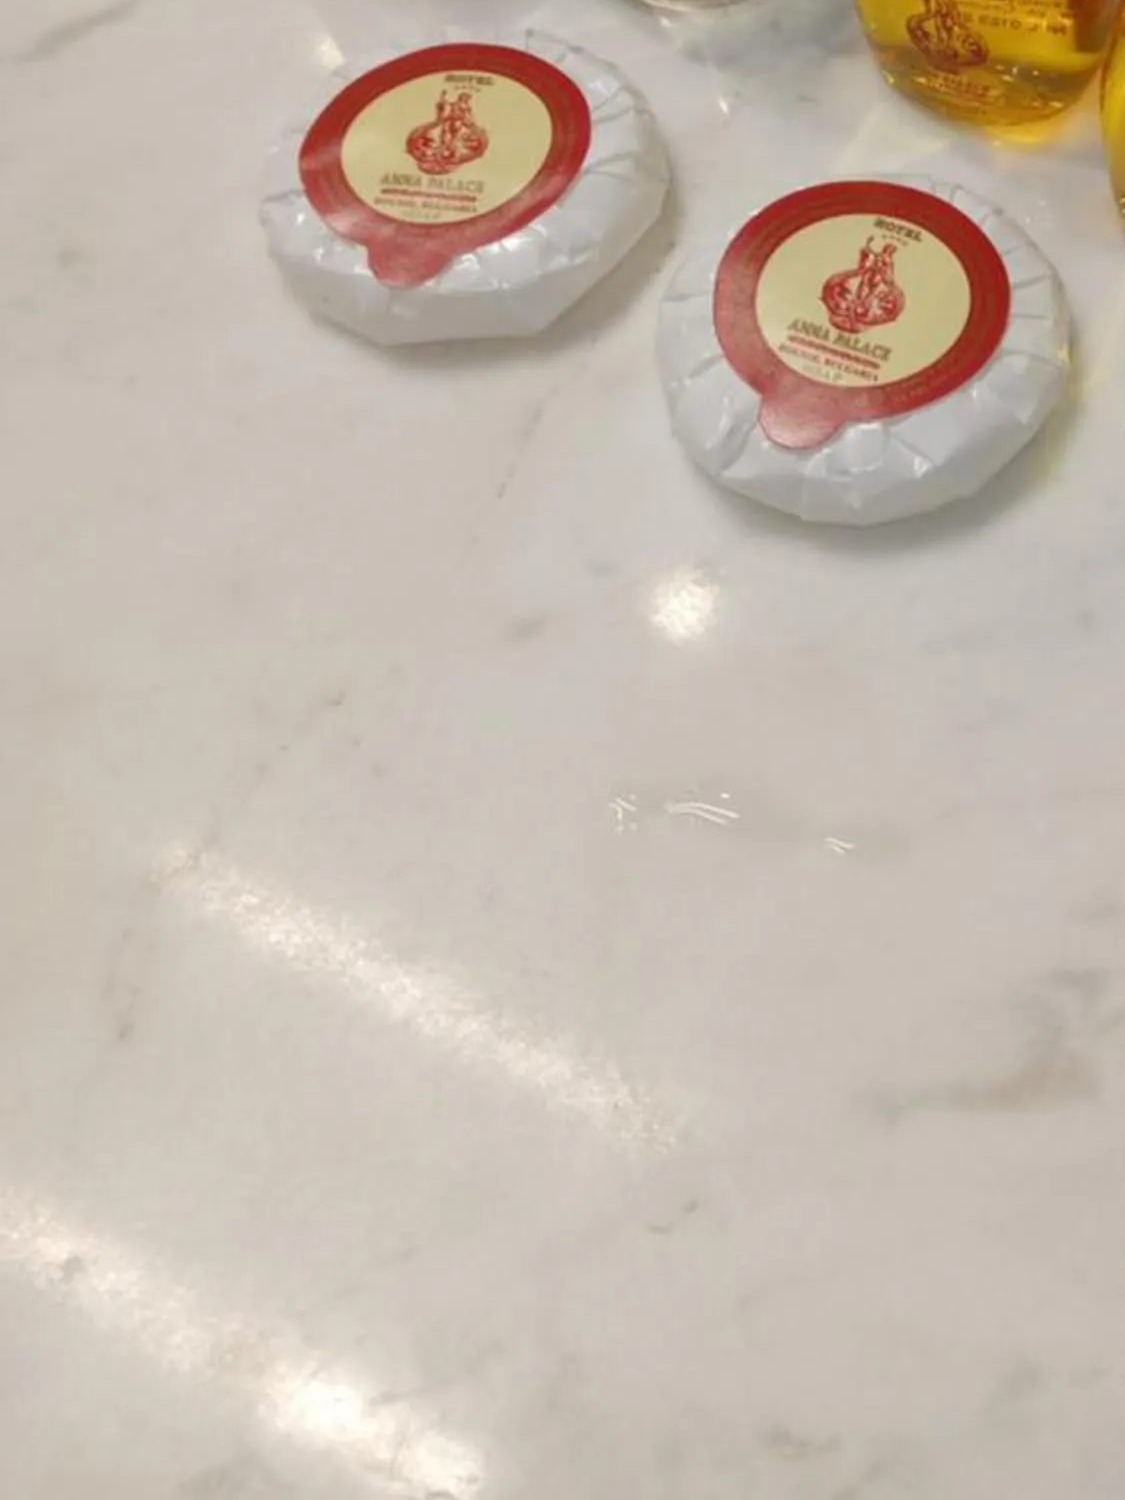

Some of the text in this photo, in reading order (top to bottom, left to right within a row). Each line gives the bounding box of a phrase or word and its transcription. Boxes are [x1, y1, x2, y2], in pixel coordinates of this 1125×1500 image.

[380, 171, 485, 194] ANNA PALACE
[874, 217, 923, 243] HOTEL
[786, 317, 831, 342] ANNA
[833, 333, 894, 363] PALACE
